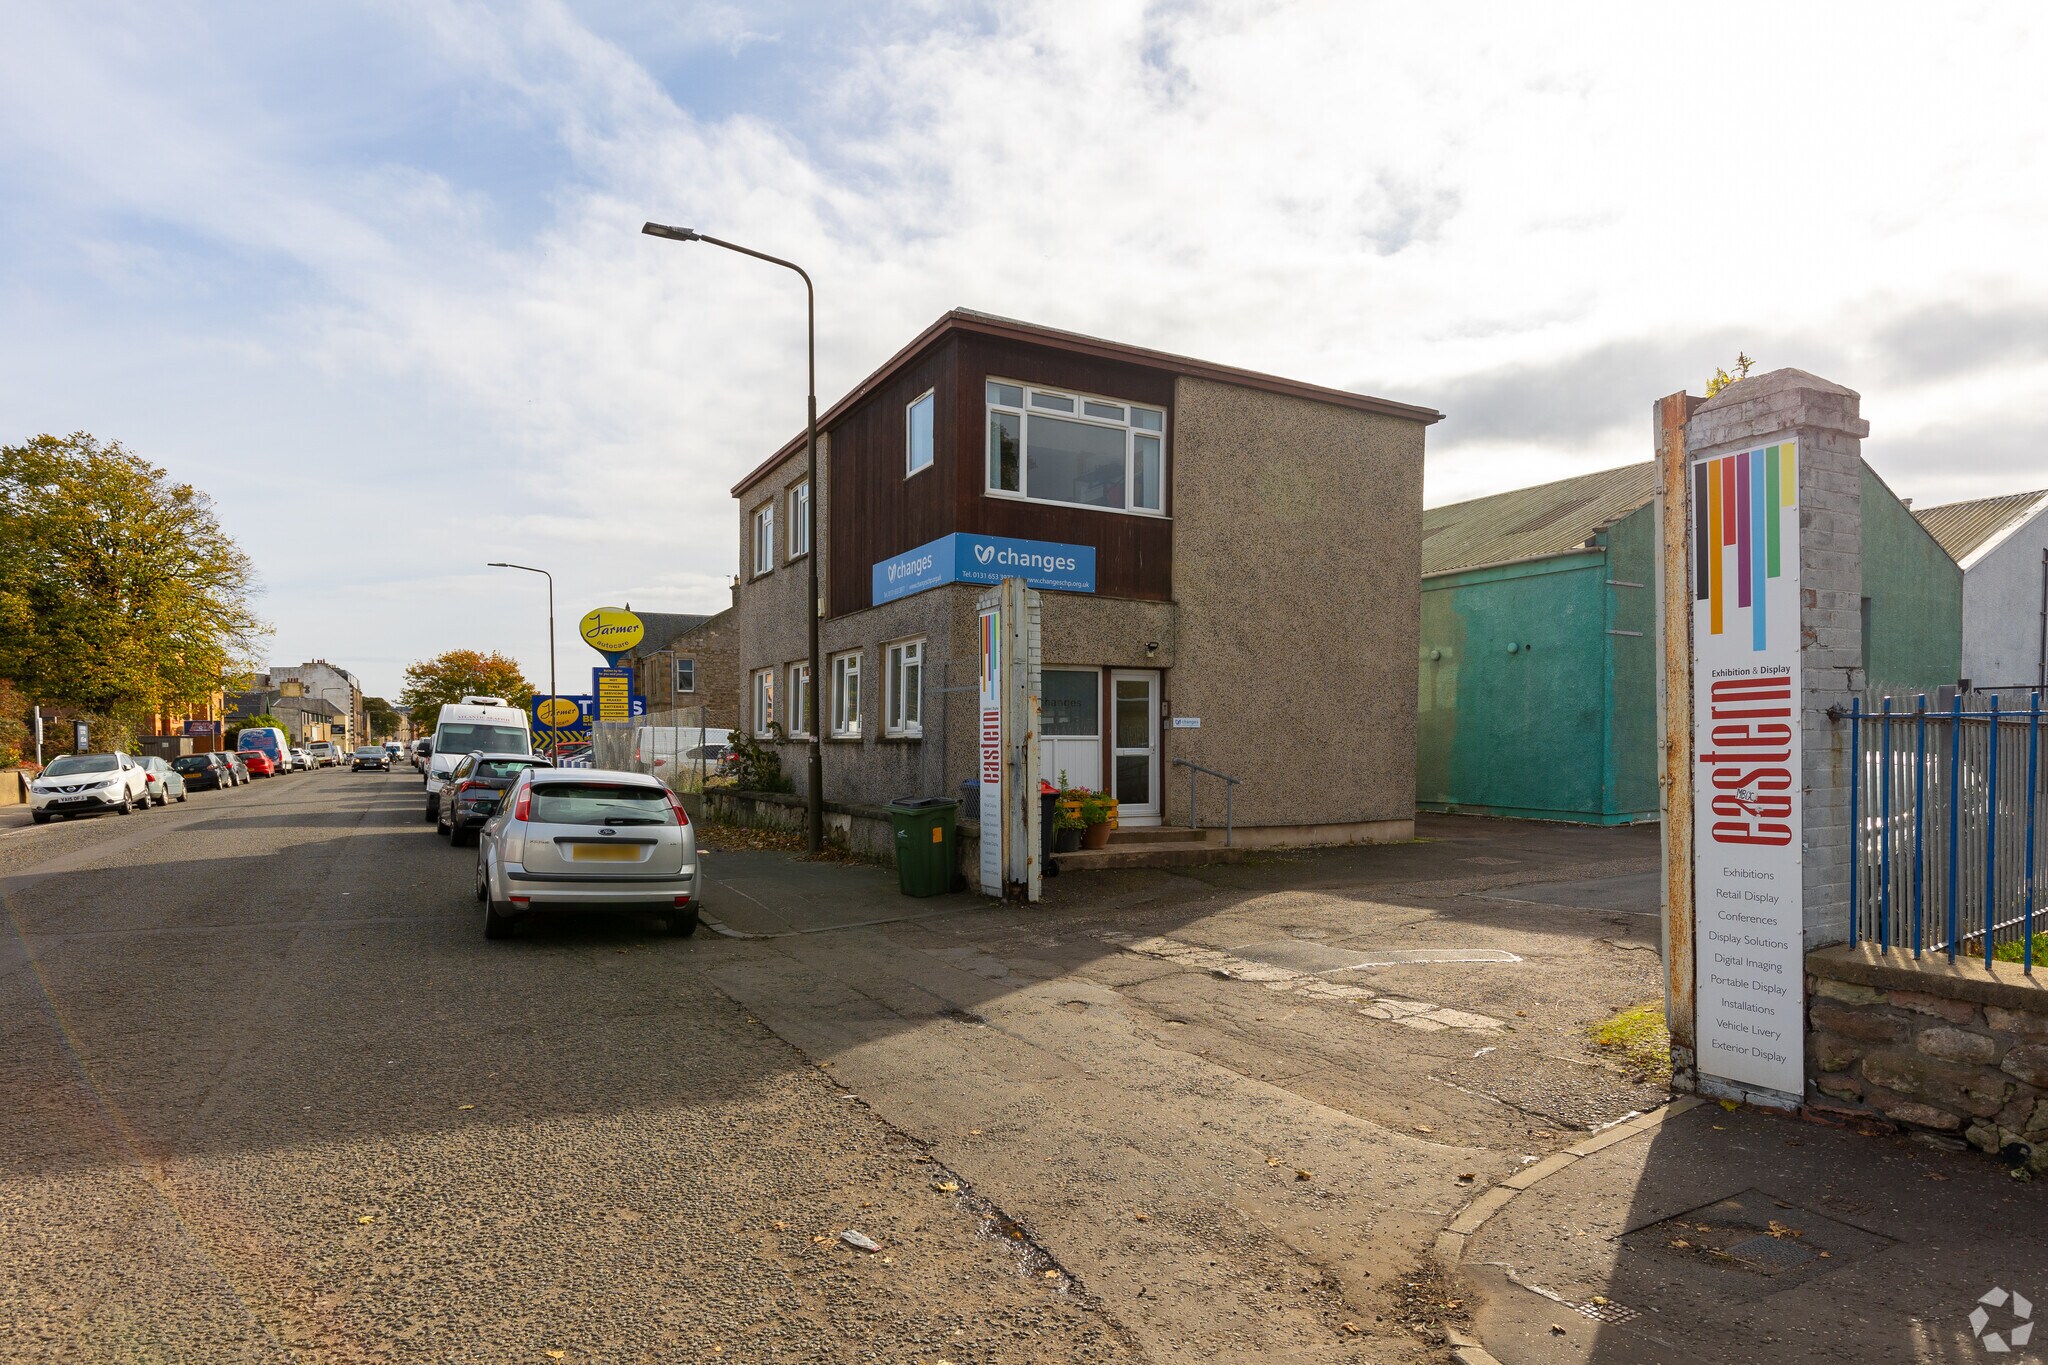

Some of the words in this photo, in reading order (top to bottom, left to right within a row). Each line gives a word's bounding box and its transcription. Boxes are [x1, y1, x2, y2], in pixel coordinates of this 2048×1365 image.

[896, 554, 933, 579] changes
[997, 548, 1076, 573] changes
[962, 570, 972, 578] Tel.
[972, 571, 987, 579] 0131
[596, 640, 630, 649] autocare
[1712, 668, 1751, 678] Exhibition
[1752, 666, 1758, 675] &
[1760, 665, 1791, 677] Display
[981, 711, 999, 784] eastern
[1700, 676, 1792, 846] eastern
[1723, 867, 1775, 880] Exhibitions
[1716, 888, 1742, 900] Retail
[1744, 890, 1779, 905] Display
[1718, 910, 1778, 926] Conferences
[1708, 930, 1741, 945] Display
[1744, 935, 1789, 950] Solutions
[1714, 953, 1743, 967] Digital
[1746, 957, 1783, 974] Imaging
[1710, 974, 1749, 989] Portable
[1752, 980, 1787, 997] Display
[1721, 997, 1775, 1016] Installations
[1716, 1018, 1749, 1033] Vehicle
[1751, 1025, 1781, 1041] Livery
[1711, 1038, 1749, 1055] Exterior
[1751, 1047, 1787, 1065] Display
